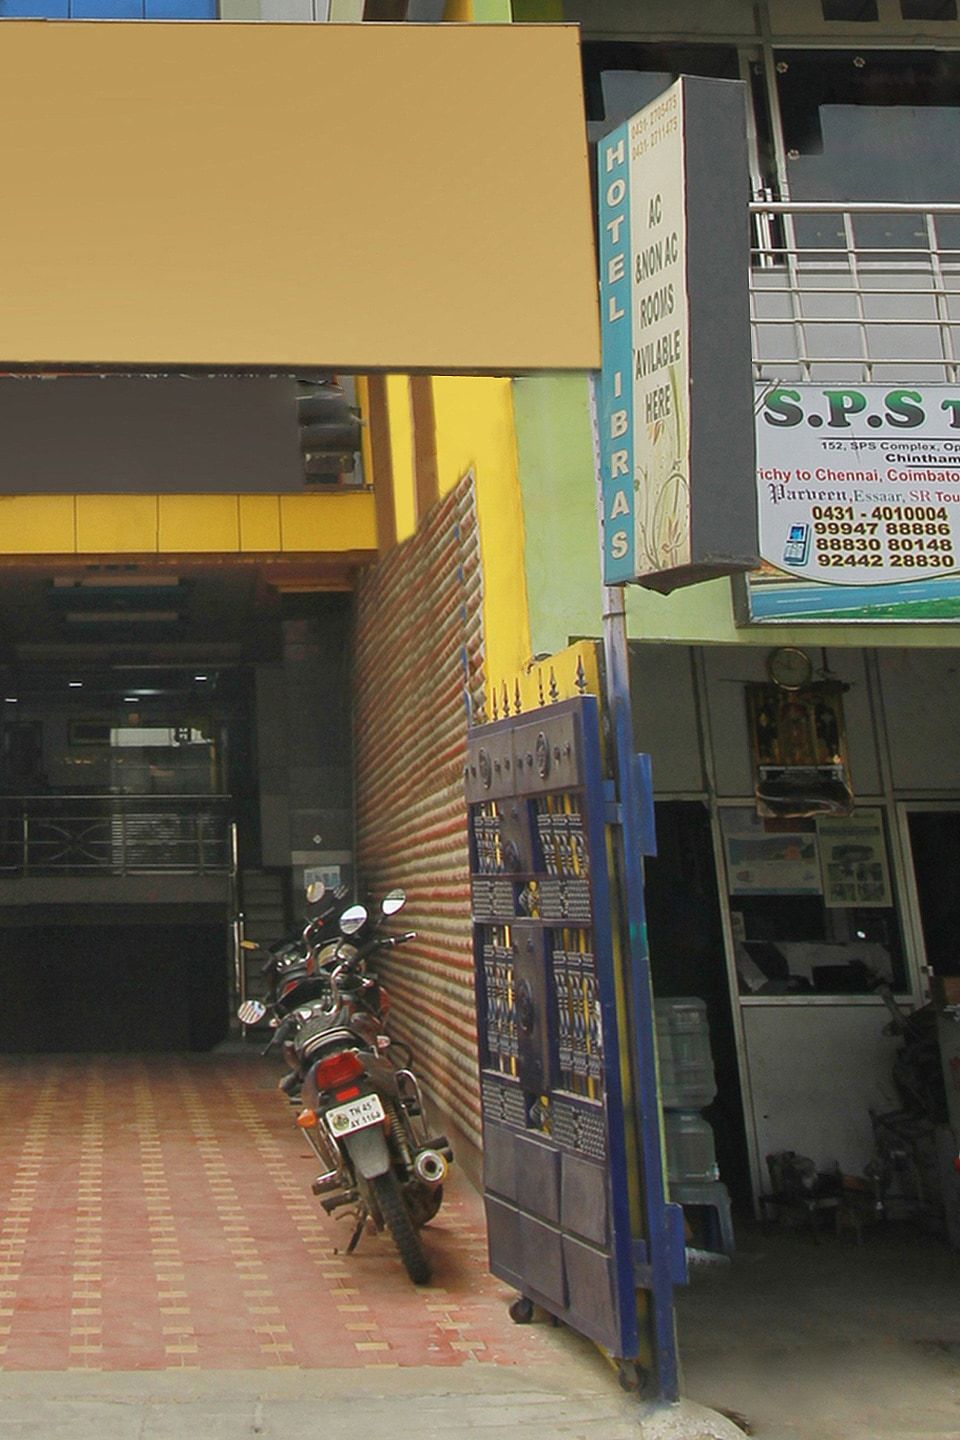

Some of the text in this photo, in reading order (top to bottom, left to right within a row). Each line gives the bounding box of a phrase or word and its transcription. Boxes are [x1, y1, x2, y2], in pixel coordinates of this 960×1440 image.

[649, 194, 662, 229] AC
[635, 231, 678, 284] &NON AC
[640, 283, 674, 330] ROOMS
[605, 139, 630, 561] HOTEL IBRAS
[646, 383, 670, 424] HERE
[764, 389, 925, 428] S.P.S
[821, 442, 847, 452] 152,
[850, 442, 877, 451] SPS
[880, 442, 940, 452] Complex,
[796, 469, 811, 481] to
[815, 469, 883, 482] Chennai,
[909, 490, 931, 502] SR
[812, 506, 854, 520] 0431
[871, 506, 949, 521] 4010004
[814, 522, 951, 536] 99947 88886
[816, 538, 952, 551] 88830 80148
[818, 554, 955, 567] 92442 28830
